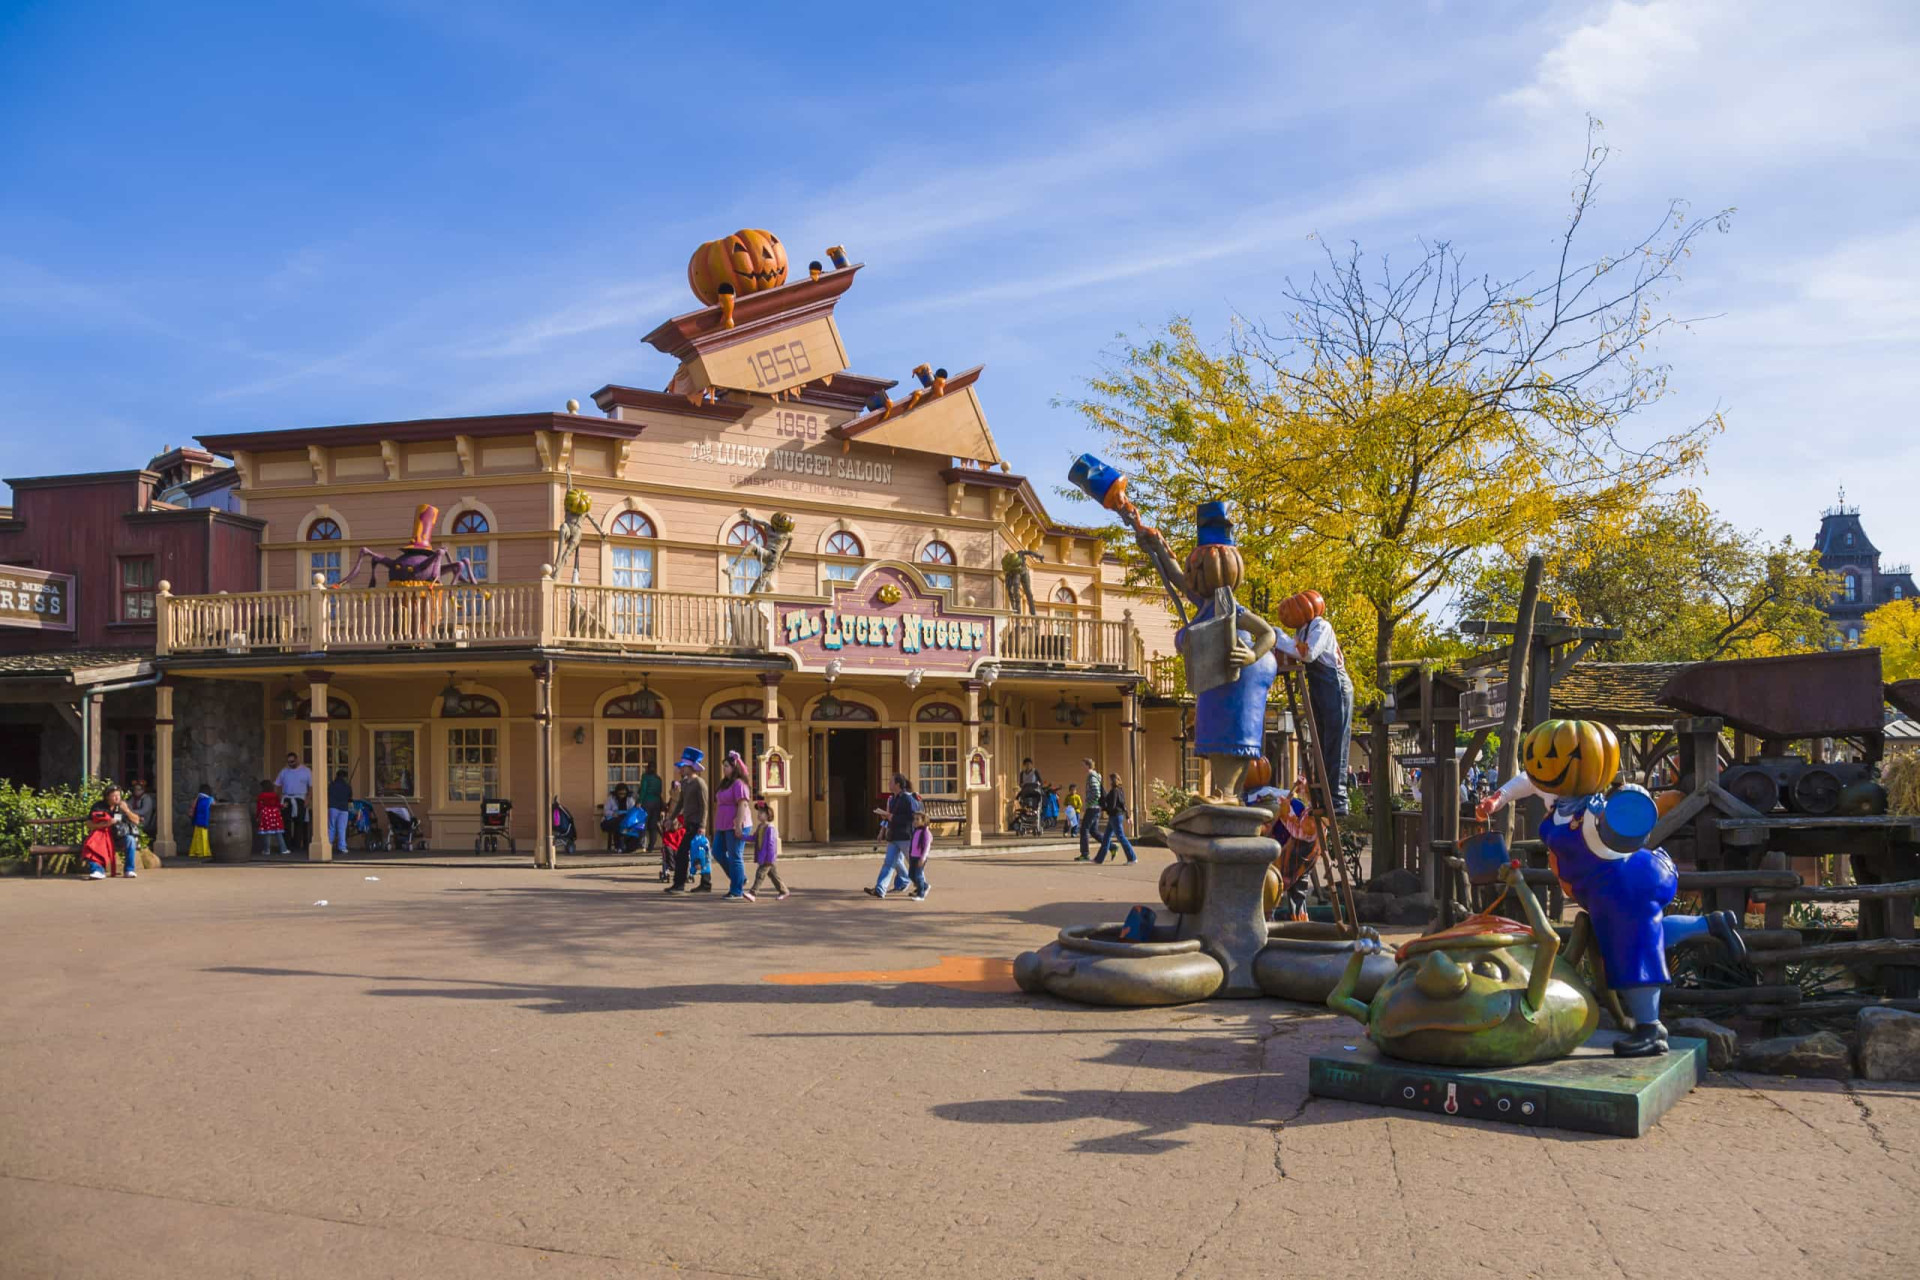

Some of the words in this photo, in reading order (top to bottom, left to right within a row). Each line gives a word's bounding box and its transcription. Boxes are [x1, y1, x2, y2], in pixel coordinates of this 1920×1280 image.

[747, 340, 811, 388] 1858
[776, 411, 817, 440] 1858
[716, 441, 770, 471] LUCKY
[774, 449, 833, 478] NUGGET
[837, 457, 893, 486] SALOON
[729, 474, 788, 489] GEMSTONE
[791, 480, 804, 491] OF
[810, 483, 827, 494] THE
[831, 486, 859, 498] WEST
[0, 590, 60, 614] RESS
[21, 582, 60, 594] MESA
[823, 608, 898, 650] LUCKY
[902, 613, 985, 653] NUGGET
